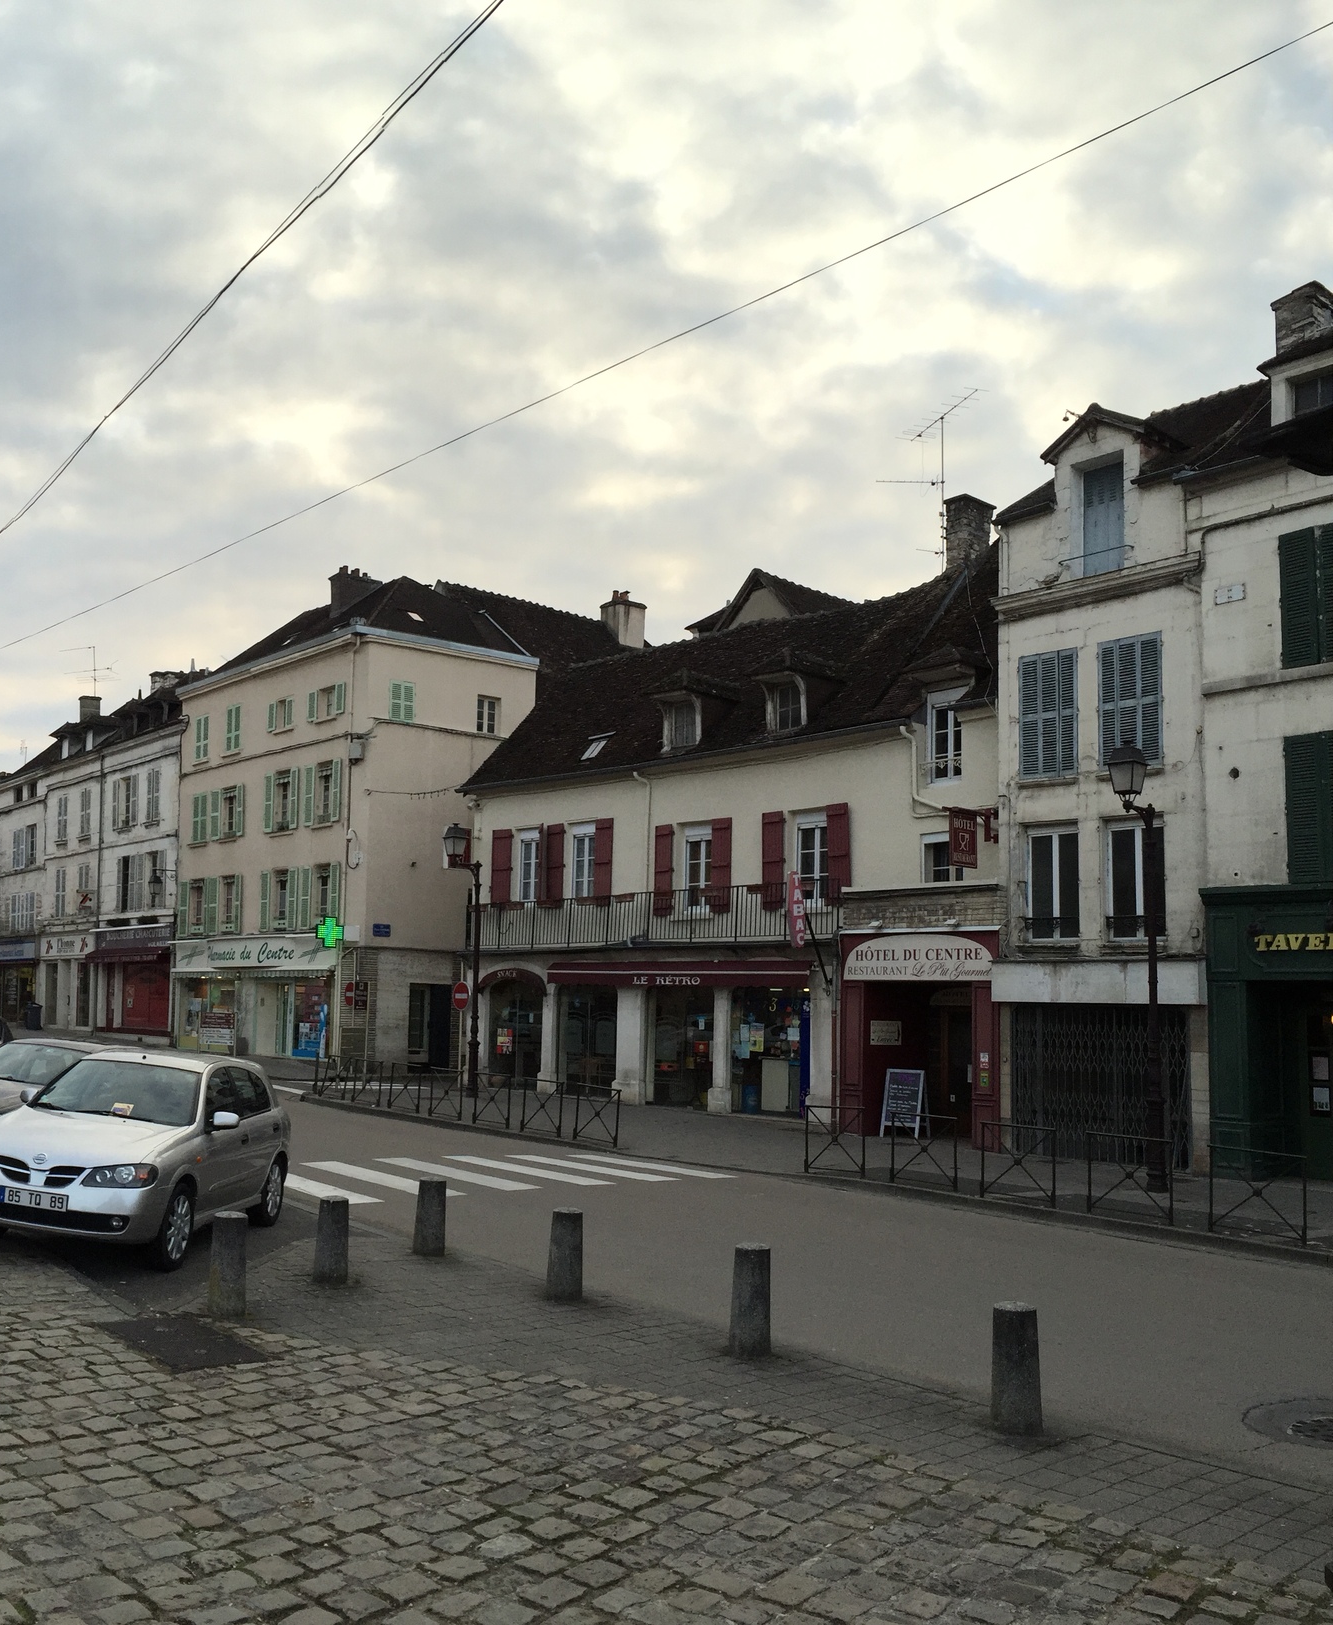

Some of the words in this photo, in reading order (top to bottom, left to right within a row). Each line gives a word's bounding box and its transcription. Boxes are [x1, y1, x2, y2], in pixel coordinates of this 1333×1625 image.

[953, 815, 975, 831] HÔTEL
[793, 874, 805, 946] TABAC
[106, 930, 134, 941] BOUCHERIE
[135, 927, 171, 939] CHARCUTERIE
[240, 944, 251, 960] du
[257, 941, 295, 964] Centre
[855, 946, 899, 962] HÔTEL
[903, 949, 921, 961] DU
[925, 947, 983, 961] CENTRE
[847, 965, 909, 976] RESTAURANT
[910, 961, 926, 978] Le
[949, 961, 992, 980] Gourmet
[632, 976, 649, 985] LE
[655, 974, 701, 986] RÉTRO
[7, 1189, 21, 1203] 85
[28, 1192, 42, 1207] TQ
[49, 1195, 64, 1210] 89
